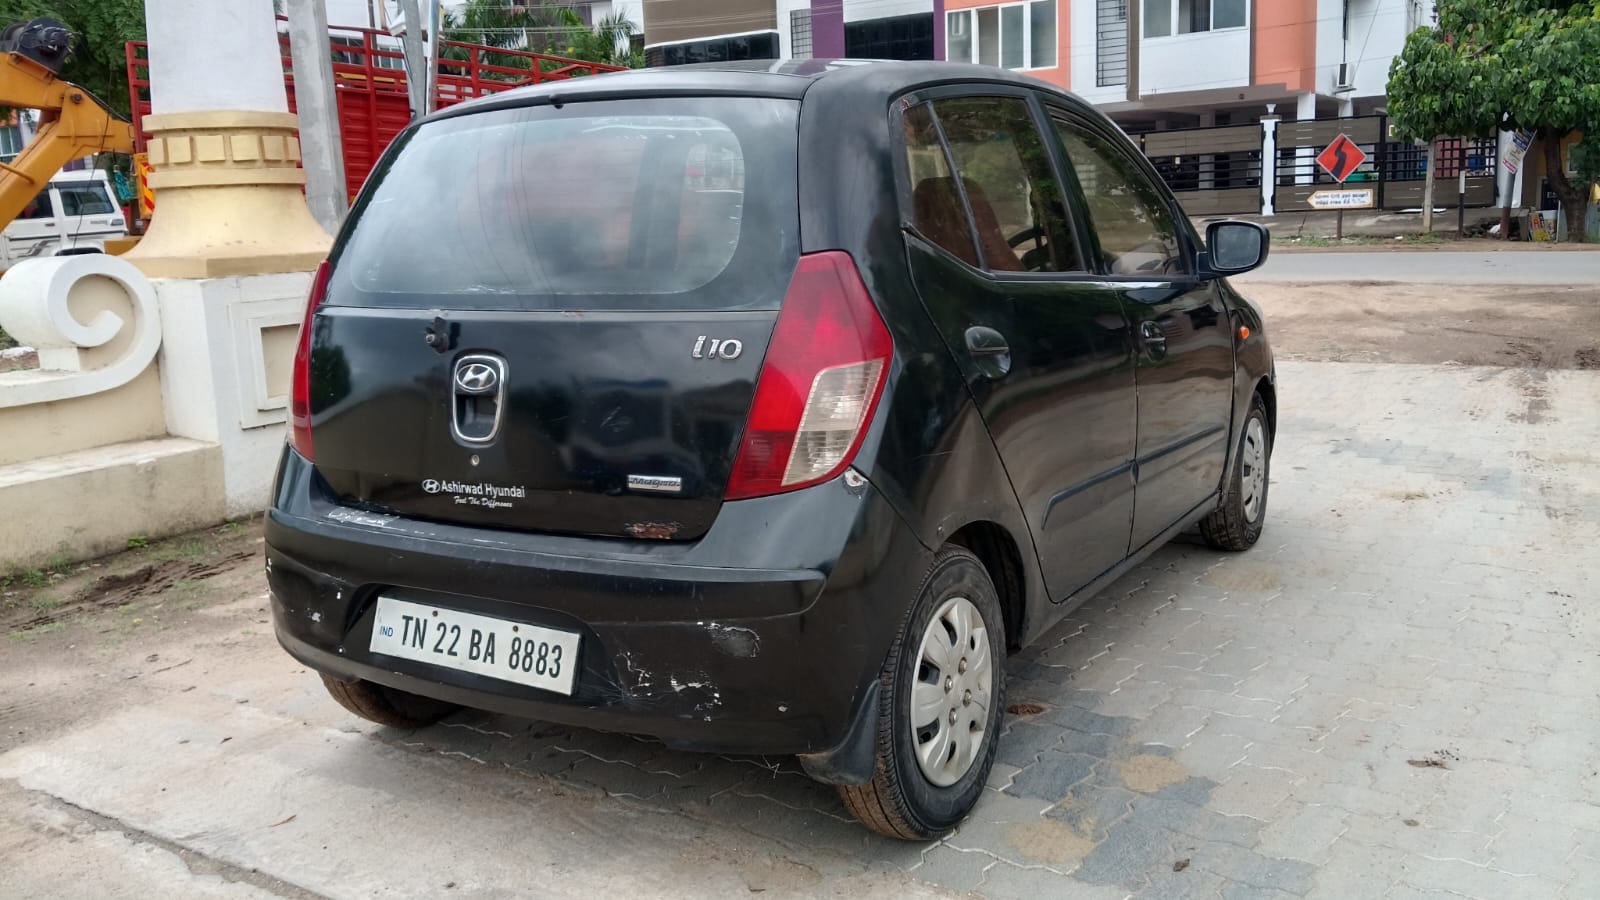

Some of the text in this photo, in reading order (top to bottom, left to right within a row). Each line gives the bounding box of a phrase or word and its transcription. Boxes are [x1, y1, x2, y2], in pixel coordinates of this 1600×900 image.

[693, 335, 743, 361] i10
[441, 480, 526, 499] Ashirwad Hyundai
[468, 497, 480, 505] The
[379, 625, 394, 637] IND
[401, 614, 563, 679] TN 22 BA 8883
